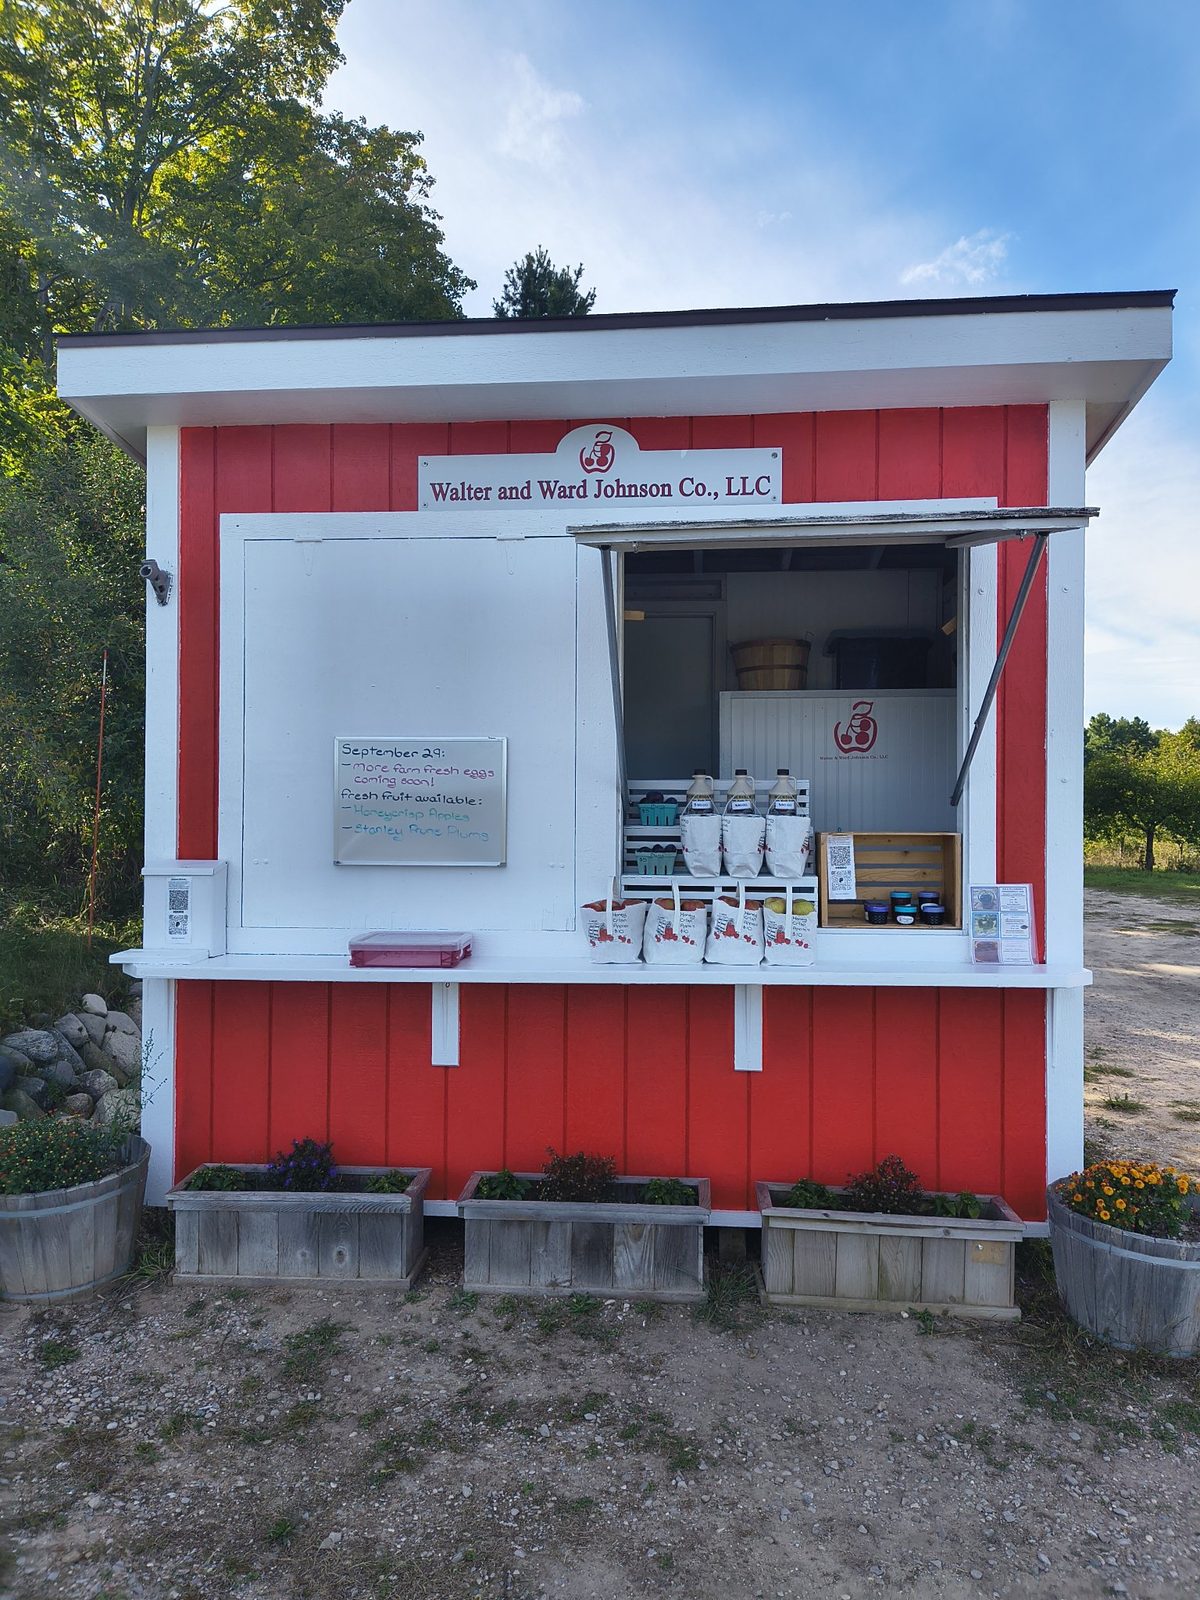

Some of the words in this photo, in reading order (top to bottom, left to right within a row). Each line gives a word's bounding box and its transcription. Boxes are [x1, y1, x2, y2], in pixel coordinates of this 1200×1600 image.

[430, 482, 492, 502] Walter
[498, 481, 532, 500] and
[537, 478, 588, 500] Ward
[594, 478, 673, 499] Johnson
[678, 477, 719, 500] Co.,
[725, 475, 771, 497] LLC
[342, 743, 418, 759] September
[422, 748, 445, 759] 29:
[423, 764, 459, 775] fresh
[463, 769, 495, 779] eggs
[354, 775, 397, 788] coming
[401, 777, 435, 787] soon!
[382, 790, 412, 801] fruit
[415, 793, 483, 806] available:
[428, 807, 470, 822] Apples
[447, 825, 489, 842] Plums
